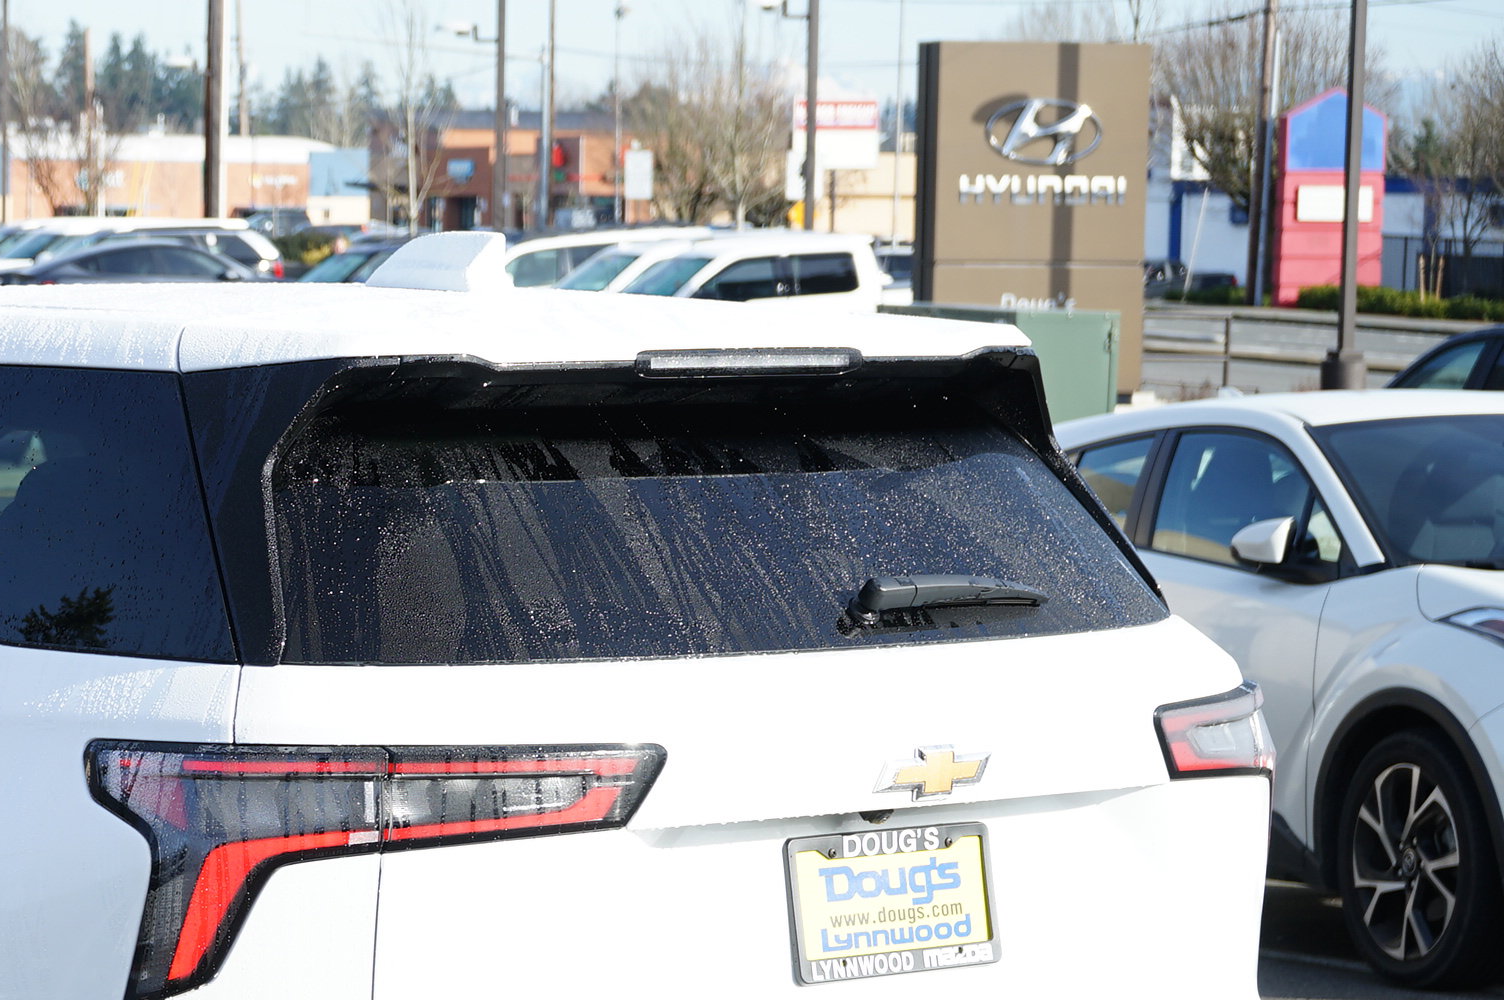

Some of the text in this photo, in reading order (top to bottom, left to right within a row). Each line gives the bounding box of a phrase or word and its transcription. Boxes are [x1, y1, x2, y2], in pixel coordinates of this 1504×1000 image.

[959, 174, 1127, 205] HYUNDAI
[842, 827, 939, 858] DOUG'S
[830, 902, 964, 928] www.dougs.com
[820, 913, 972, 953] Lynnwood
[810, 951, 915, 982] LYNNWOOD
